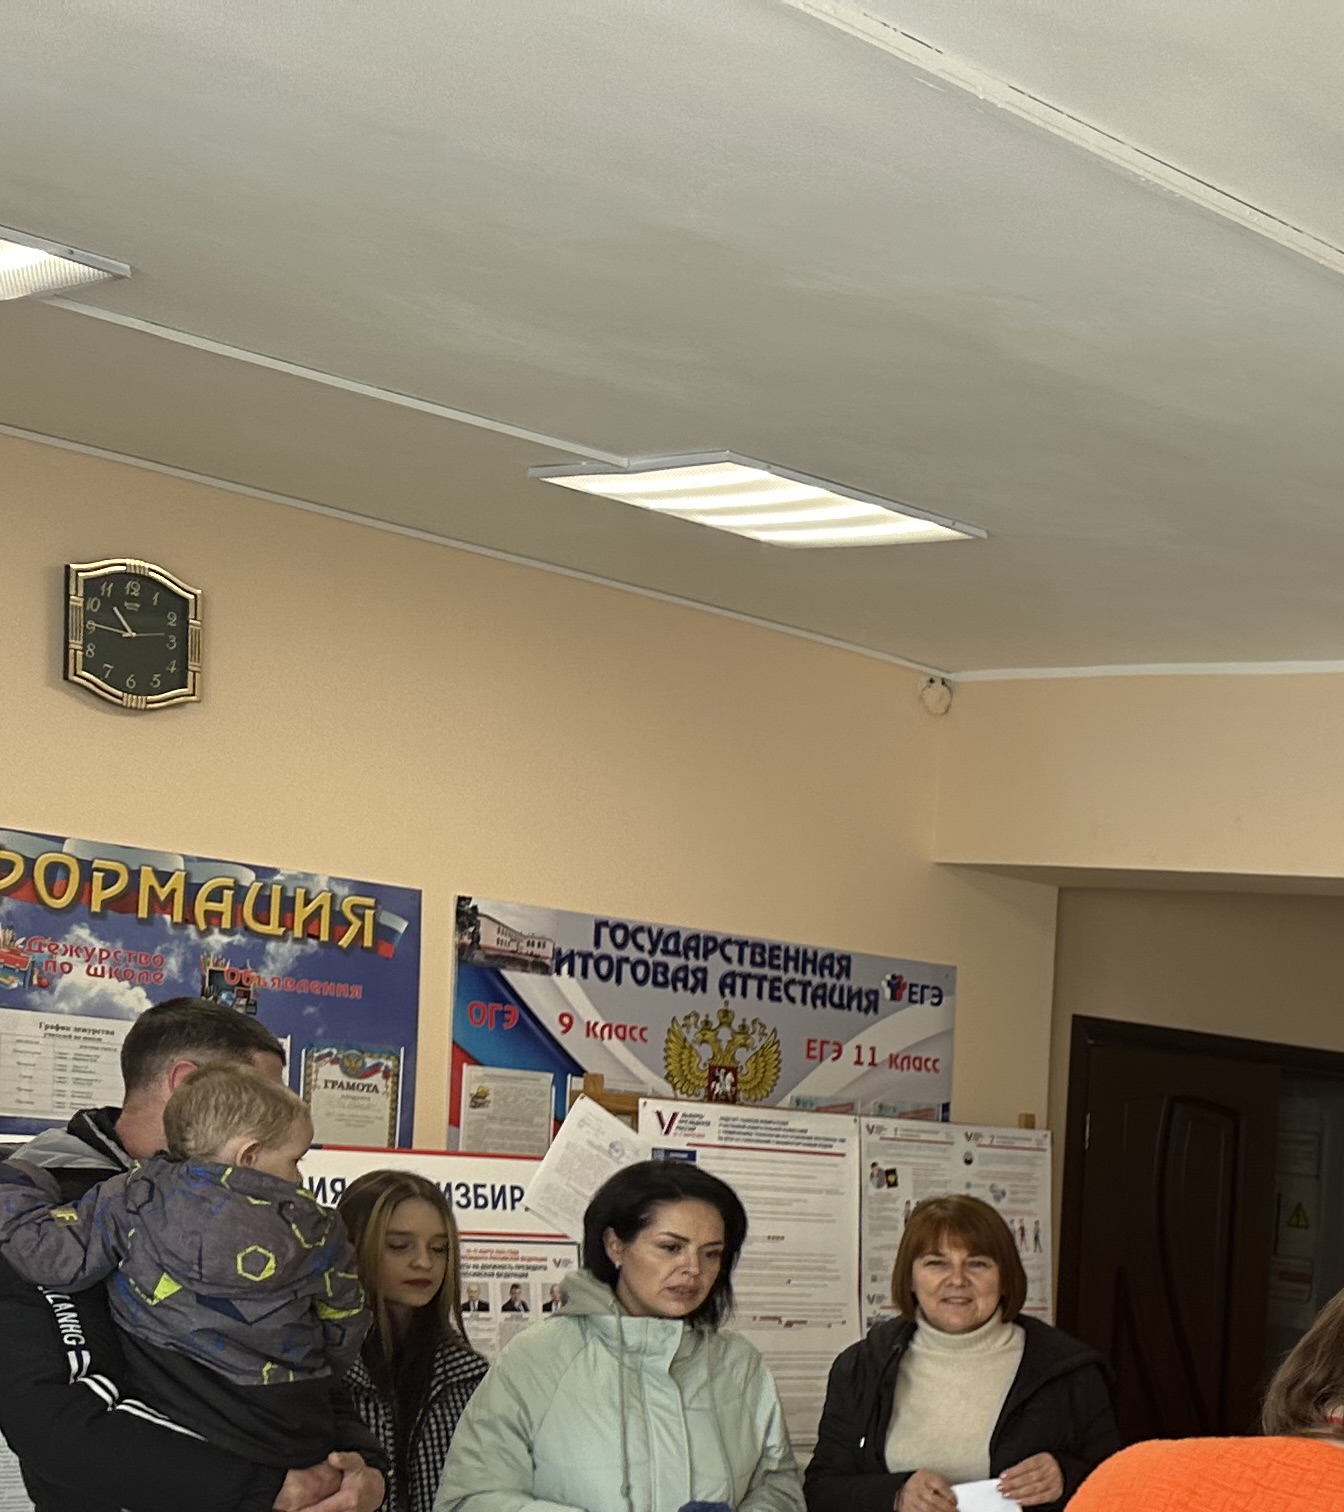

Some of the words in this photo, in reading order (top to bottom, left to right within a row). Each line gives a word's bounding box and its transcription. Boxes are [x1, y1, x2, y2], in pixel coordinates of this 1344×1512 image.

[101, 582, 114, 597] 11
[125, 581, 141, 597] 12
[86, 597, 101, 612] 10
[152, 591, 160, 606] 1
[86, 620, 96, 635] 9
[166, 612, 178, 627] 2
[86, 643, 96, 658] 8
[166, 635, 177, 650] 3
[102, 663, 114, 679] 7
[166, 660, 177, 674] 4
[125, 674, 137, 689] 6
[150, 674, 161, 688] 5
[24, 935, 165, 968] Дежурство
[593, 918, 852, 981] ГОСУДАРСТВЕННАЯ
[43, 957, 73, 975] по
[86, 964, 165, 986] школе
[554, 946, 708, 995] ИТОГОВАЯ
[719, 968, 880, 1016] АТТЕСТАЦИЯ
[907, 982, 944, 1007] ЕГЭ
[468, 1002, 519, 1029] ОГЭ
[558, 1012, 574, 1036] 9
[585, 1020, 649, 1044] класс
[805, 1038, 843, 1062] ЕГЭ
[853, 1045, 878, 1068] 11
[887, 1051, 941, 1075] класс
[323, 1079, 380, 1095] ГРАМОТА
[438, 1182, 531, 1212] ИЗБИР
